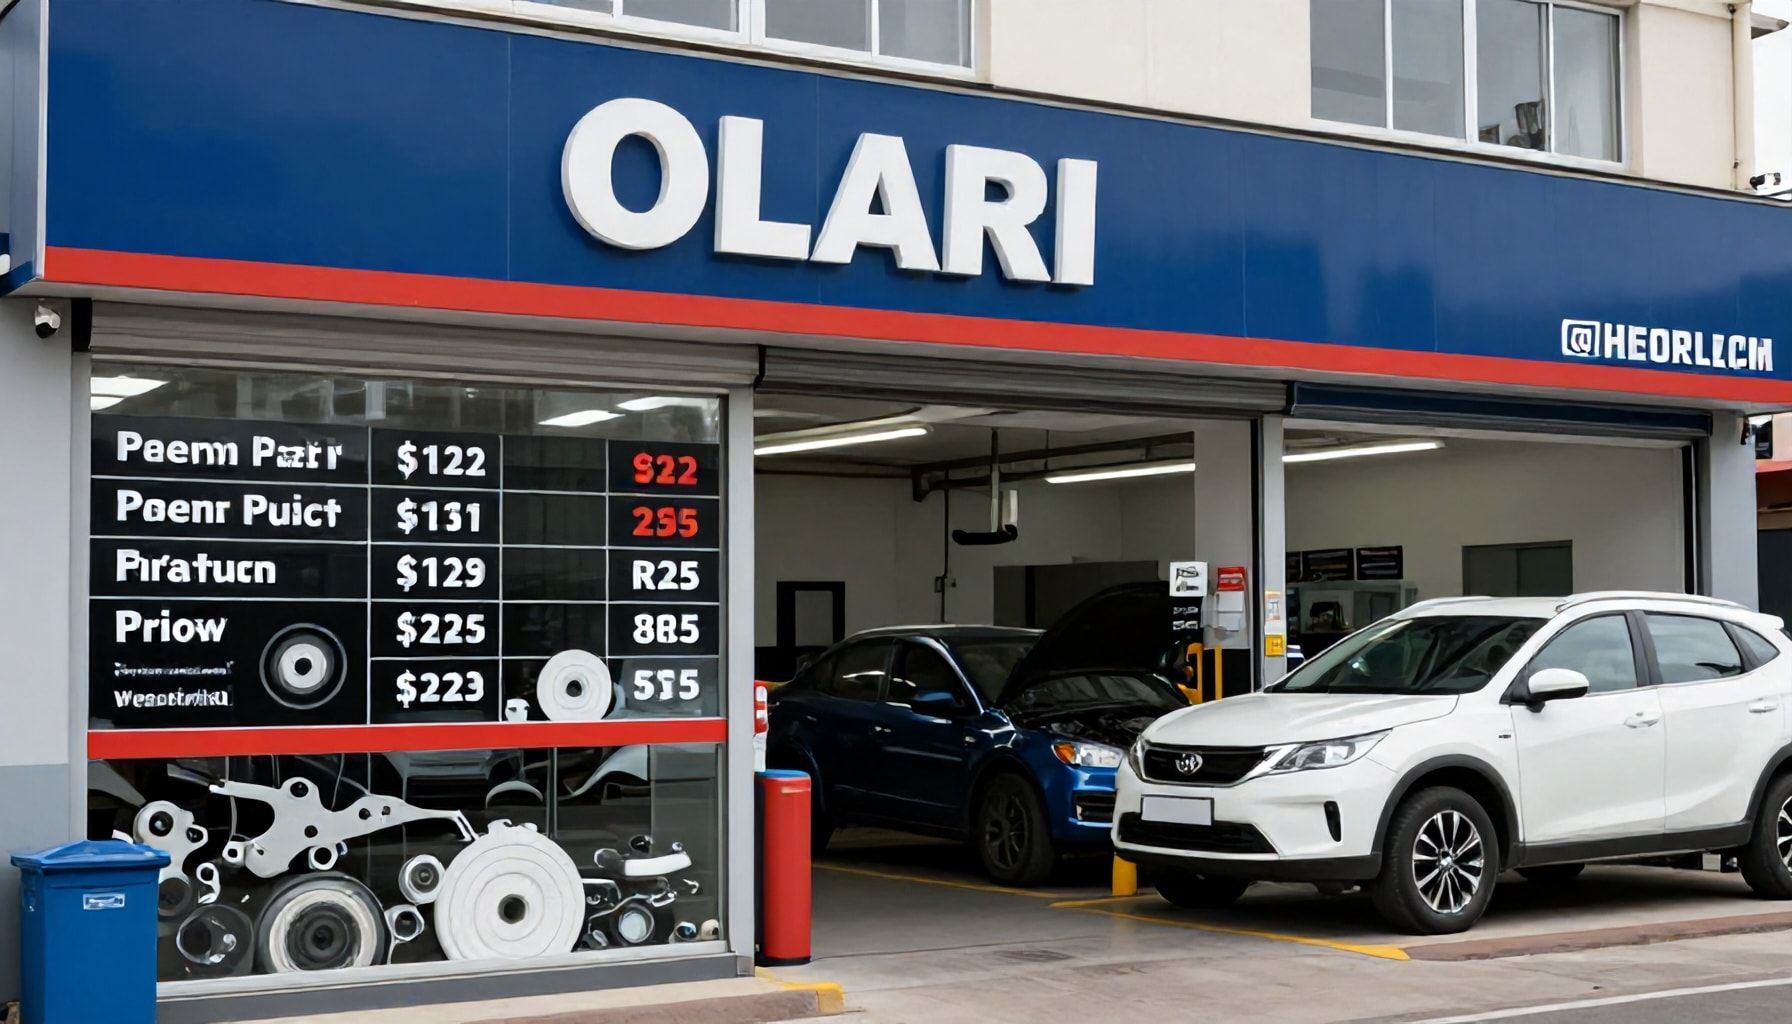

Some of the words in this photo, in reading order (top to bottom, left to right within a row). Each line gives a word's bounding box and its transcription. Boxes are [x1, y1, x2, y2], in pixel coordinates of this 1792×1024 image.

[560, 97, 1098, 286] OLARI
[397, 440, 486, 480] $122
[396, 554, 486, 592] $129
[632, 559, 700, 591] R25
[396, 611, 486, 648] $225
